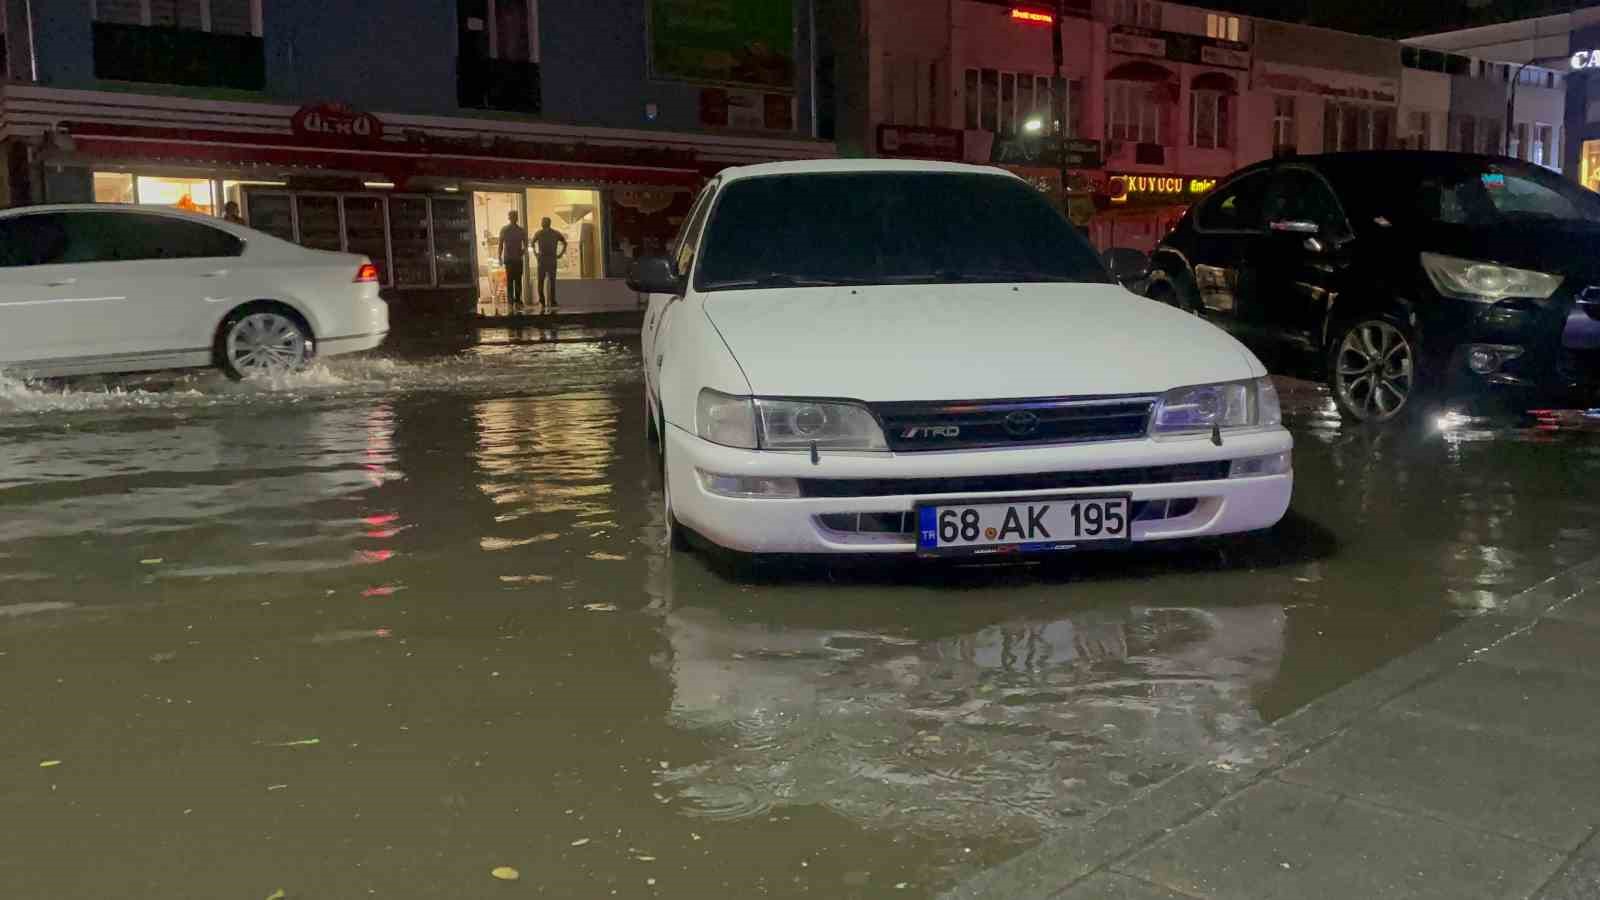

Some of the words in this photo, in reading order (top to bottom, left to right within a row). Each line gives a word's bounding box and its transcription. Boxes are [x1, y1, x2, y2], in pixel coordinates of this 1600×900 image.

[1128, 176, 1183, 192] KUYUCU
[924, 425, 960, 438] TRD
[922, 530, 936, 541] TR
[938, 509, 979, 542] 68
[998, 504, 1050, 540] AK
[1070, 502, 1124, 537] 195
